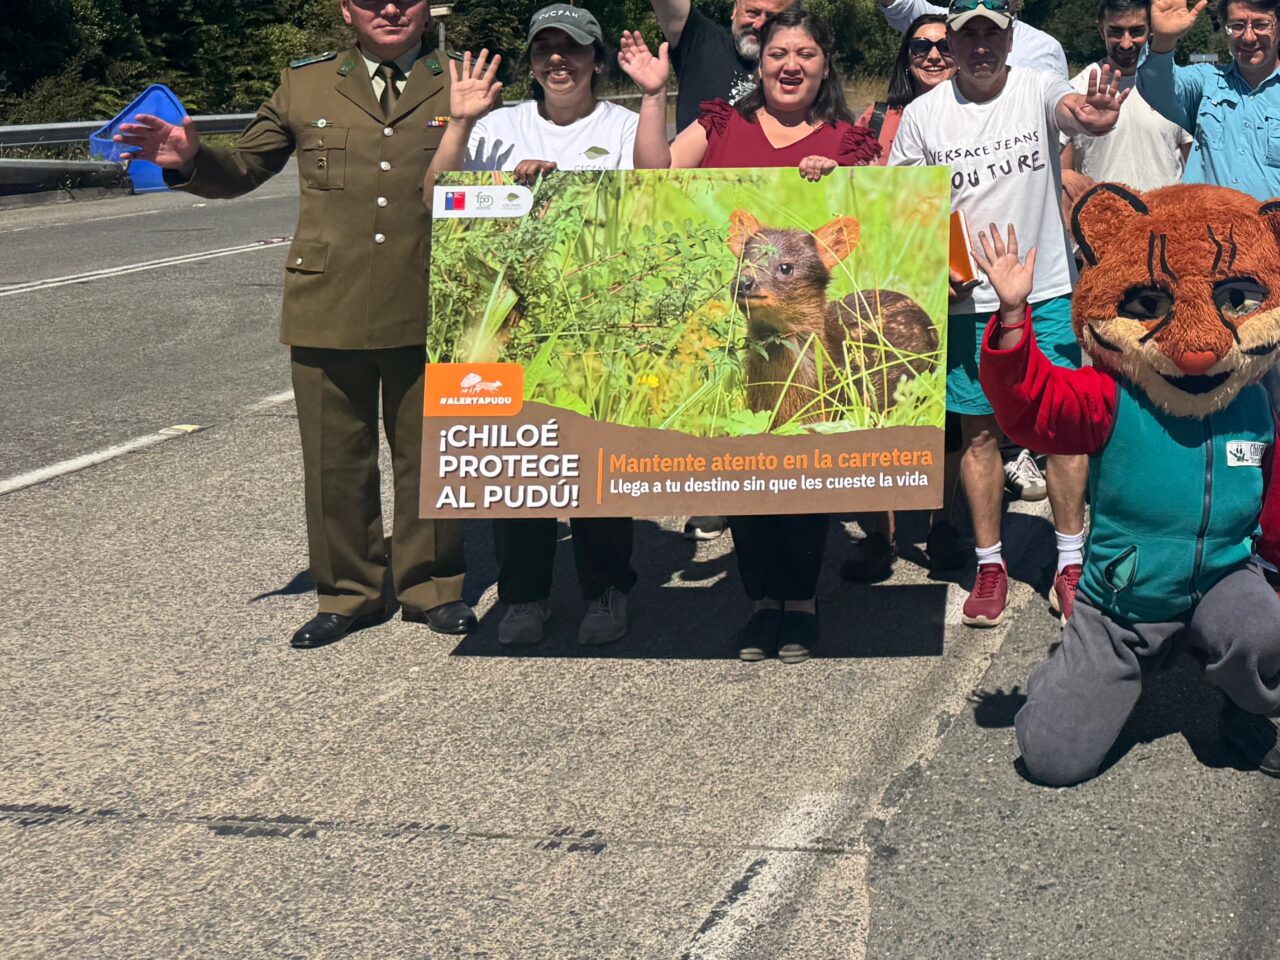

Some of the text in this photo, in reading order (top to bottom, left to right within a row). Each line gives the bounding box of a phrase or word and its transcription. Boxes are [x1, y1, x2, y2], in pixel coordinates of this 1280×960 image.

[929, 131, 1039, 165] VERSACE JEANS
[951, 150, 1045, 190] OUTURE
[439, 396, 512, 405] #ALERTAPUDU
[439, 418, 559, 452] ¡CHILOÉ
[438, 454, 580, 478] PROTEGE
[609, 448, 934, 473] Mantente atento en la carretera
[435, 479, 580, 508] AL PUDÚ!
[610, 471, 928, 497] Llega a tu destino sin que les cueste la vida
